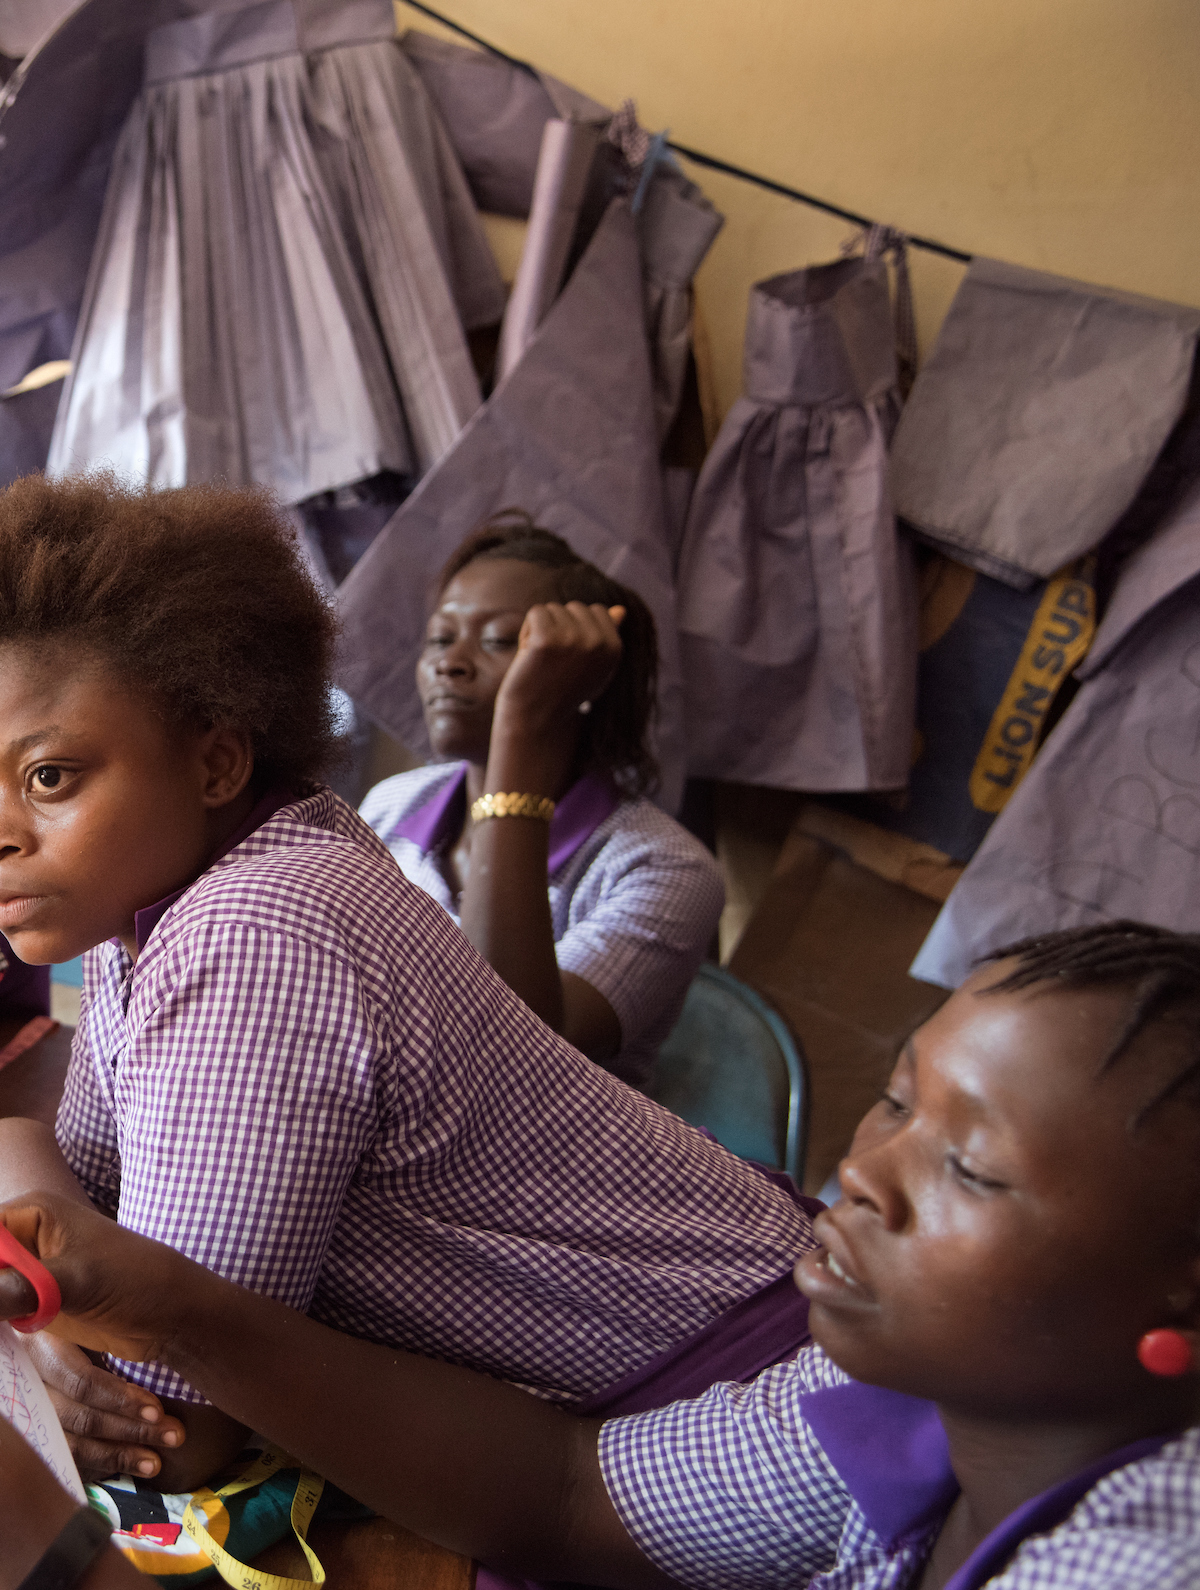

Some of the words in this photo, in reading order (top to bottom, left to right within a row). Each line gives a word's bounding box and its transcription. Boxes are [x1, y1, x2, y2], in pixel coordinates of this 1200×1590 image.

[304, 1490, 318, 1507] 31
[186, 1519, 196, 1537] 24
[211, 1549, 221, 1566] 25
[242, 1577, 261, 1590] 26
